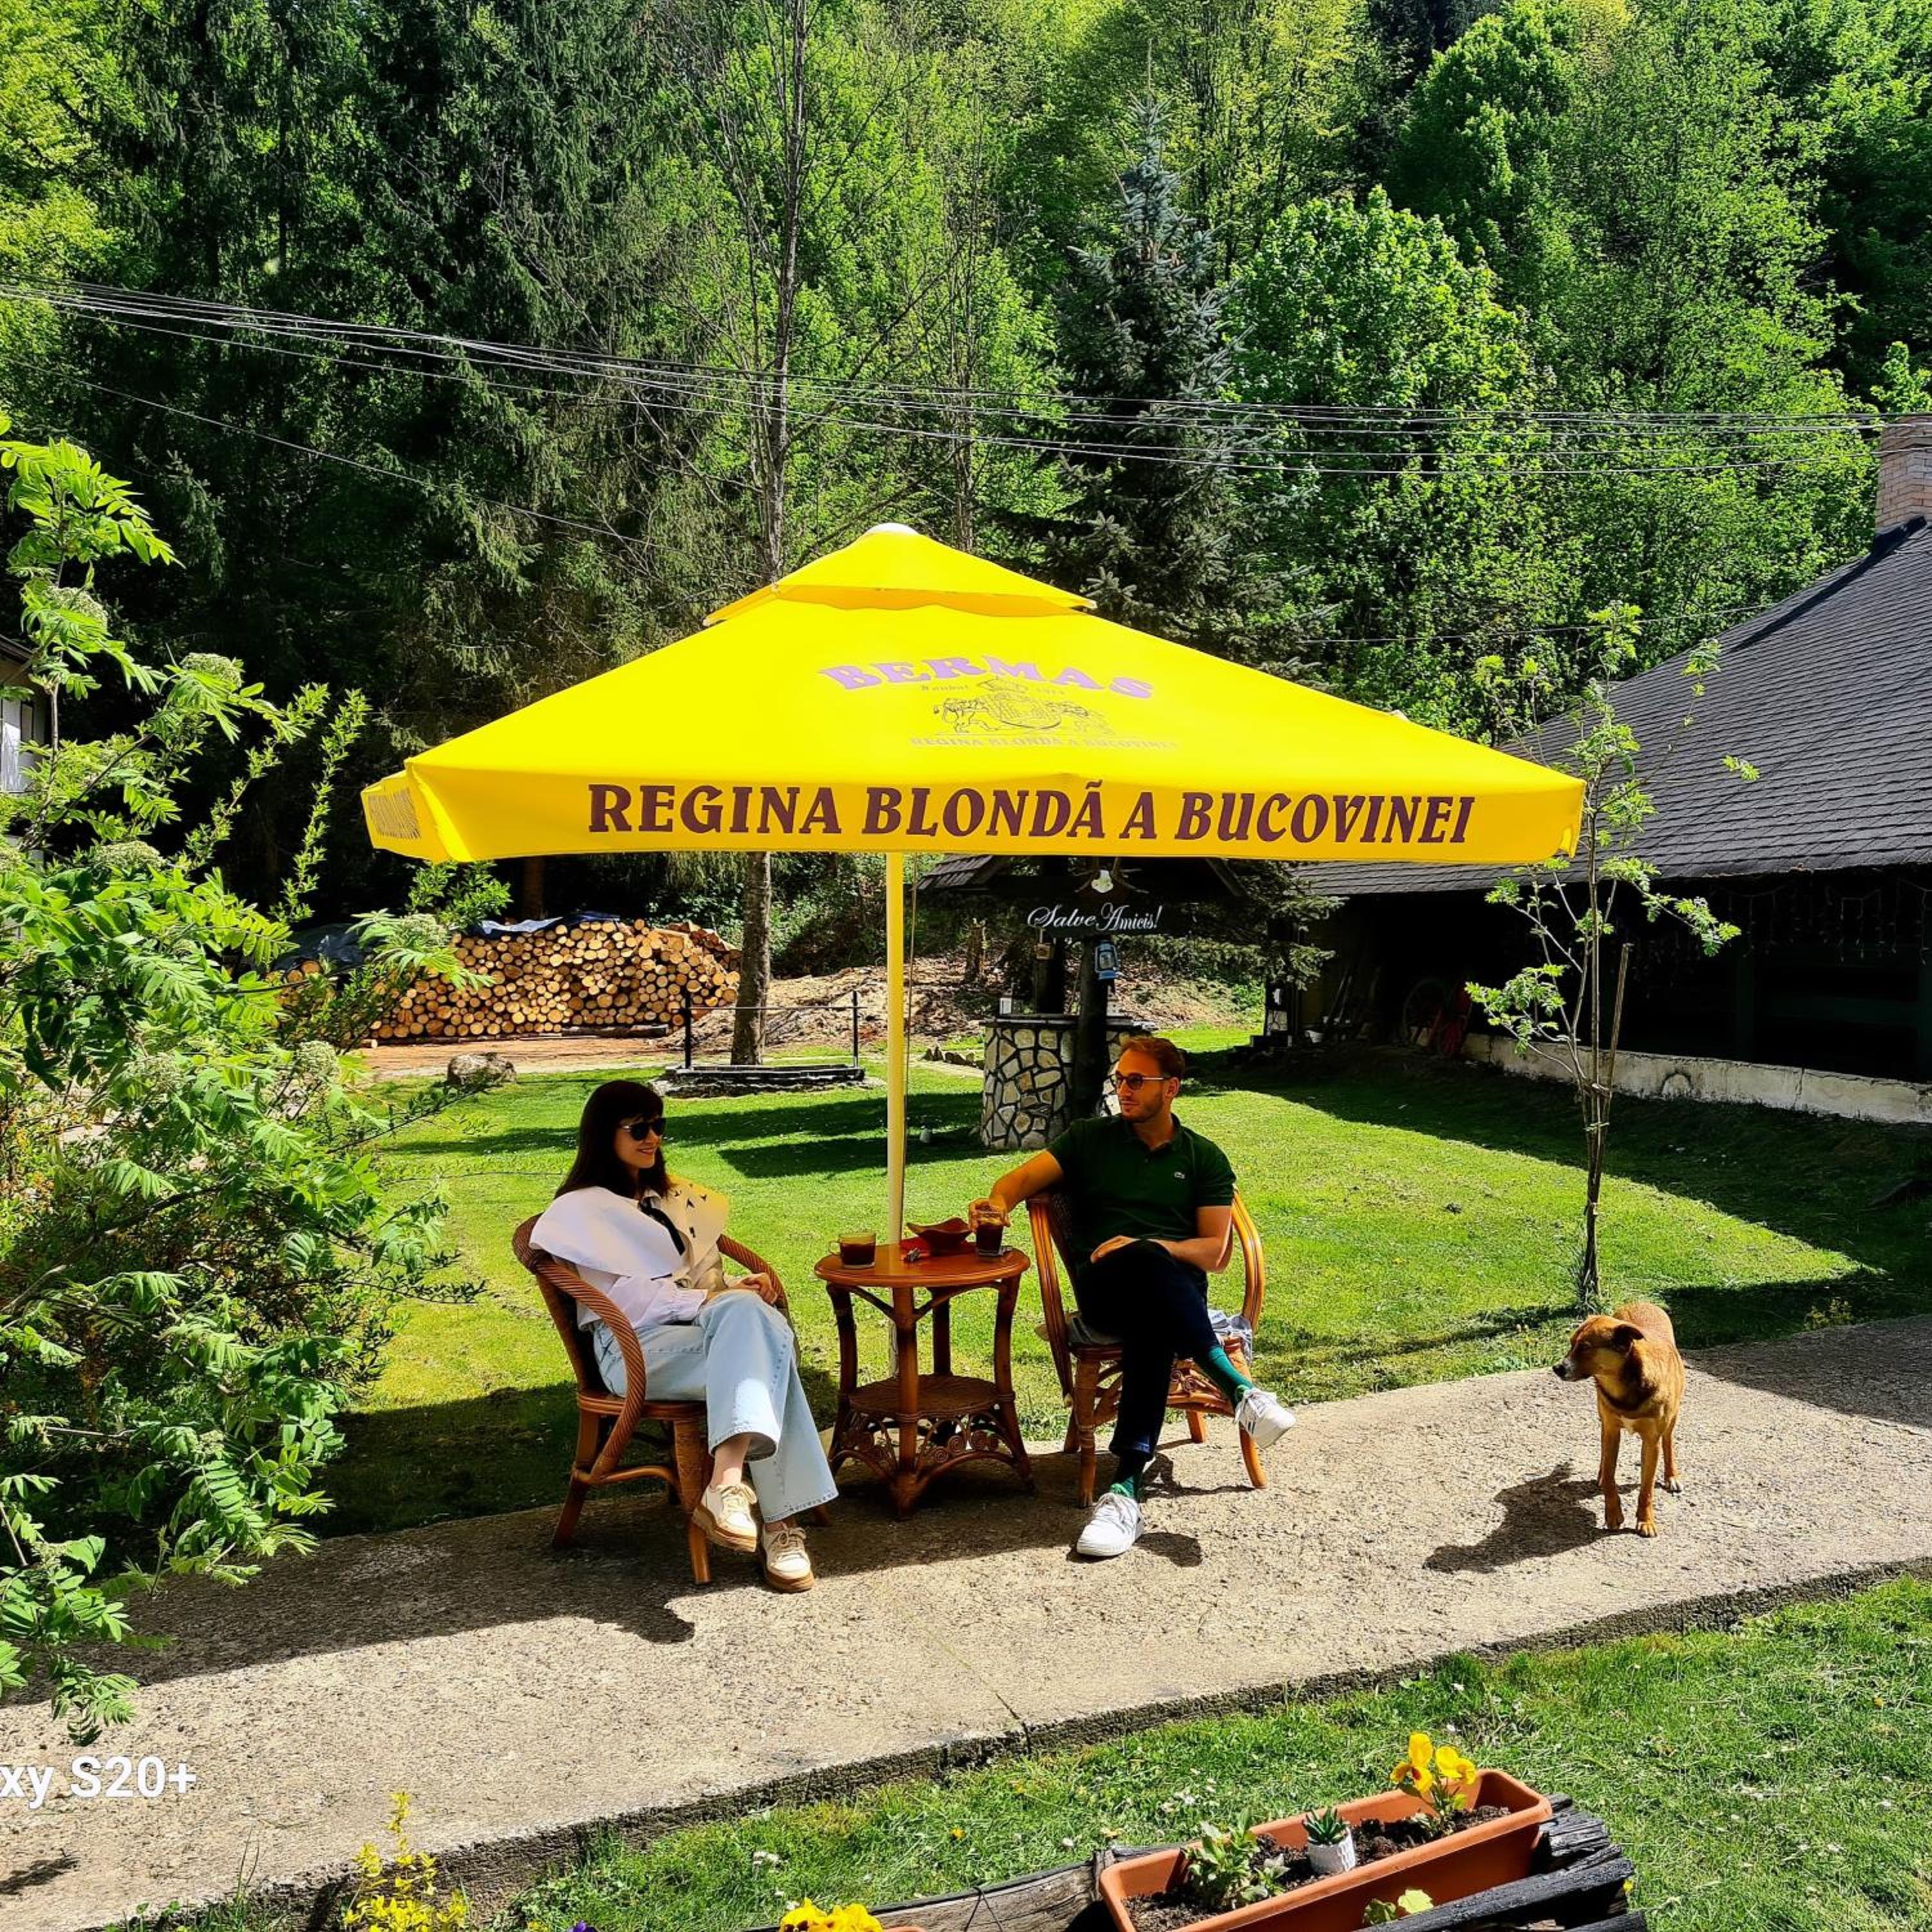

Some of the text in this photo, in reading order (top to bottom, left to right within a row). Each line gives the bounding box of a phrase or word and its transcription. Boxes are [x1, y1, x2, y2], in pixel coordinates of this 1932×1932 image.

[820, 656, 1154, 698] BERMAS
[589, 784, 842, 834] REGINA
[1119, 791, 1157, 839] A
[1174, 792, 1475, 844] BUCOVINEI
[1027, 902, 1162, 931] Salve Amicis!
